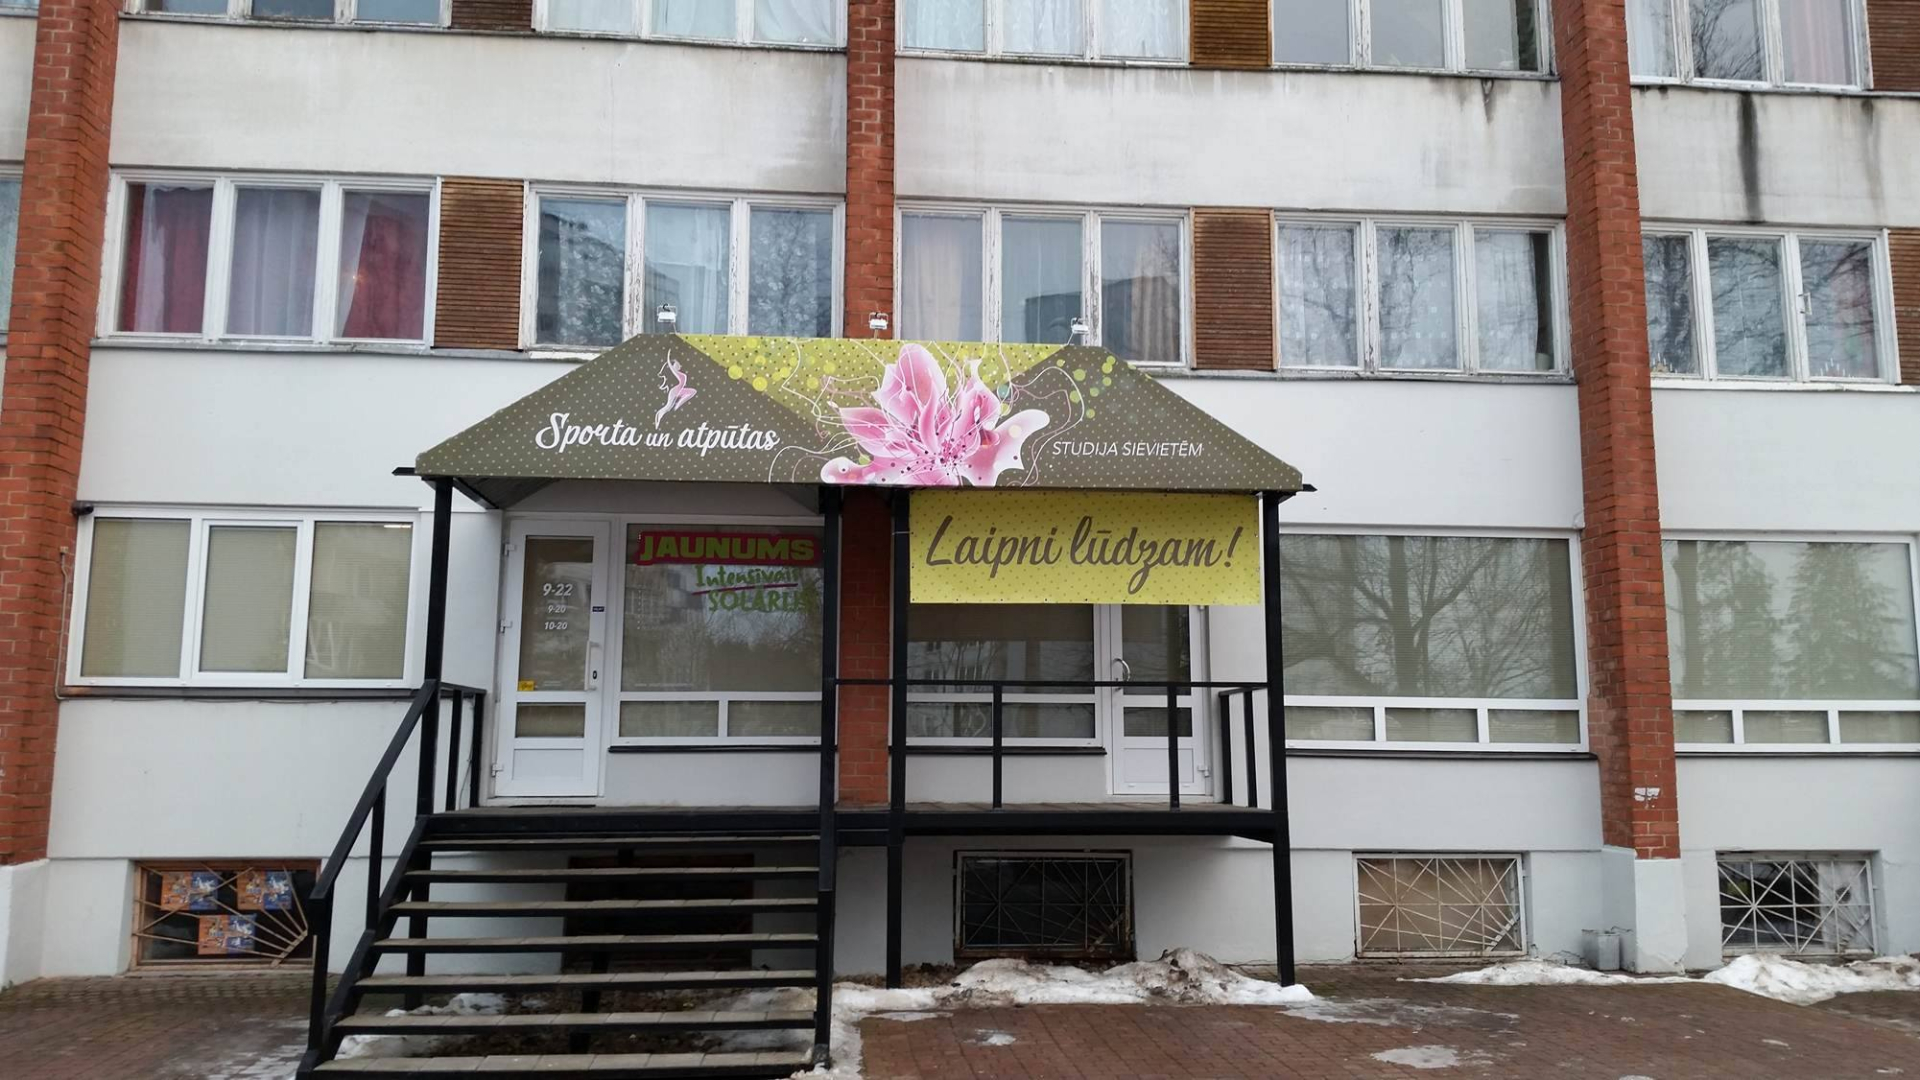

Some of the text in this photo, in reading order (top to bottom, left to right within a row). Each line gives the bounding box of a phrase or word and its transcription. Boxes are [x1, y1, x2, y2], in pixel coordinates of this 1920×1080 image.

[535, 412, 780, 457] Sporta un atpūtas
[1052, 440, 1203, 457] STUDIJA SIEVIETĒM
[639, 536, 815, 561] JAUNUMS
[926, 514, 1243, 594] Laipni lūdzam!
[543, 583, 573, 596] 9-22
[548, 604, 566, 613] 9-20
[544, 621, 568, 630] 10-20
